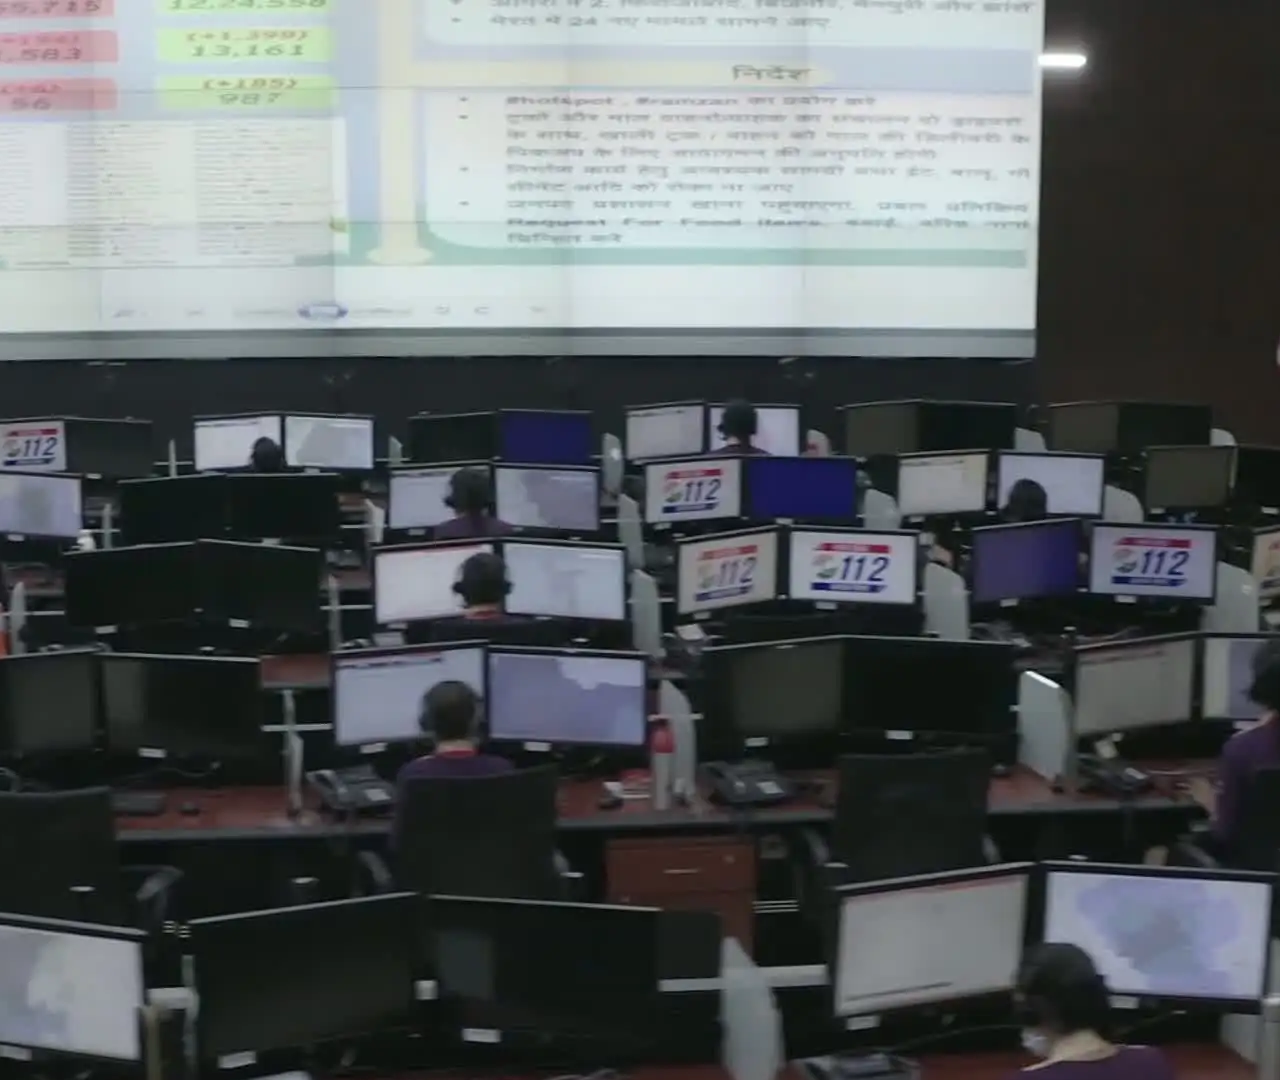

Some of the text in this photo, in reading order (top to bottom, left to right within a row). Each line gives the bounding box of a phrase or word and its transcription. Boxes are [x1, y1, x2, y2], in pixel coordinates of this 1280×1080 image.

[192, 44, 304, 57] 13,161
[20, 436, 59, 460] 112
[683, 478, 721, 502] 112
[834, 555, 891, 583] 112
[1134, 550, 1190, 577] 112
